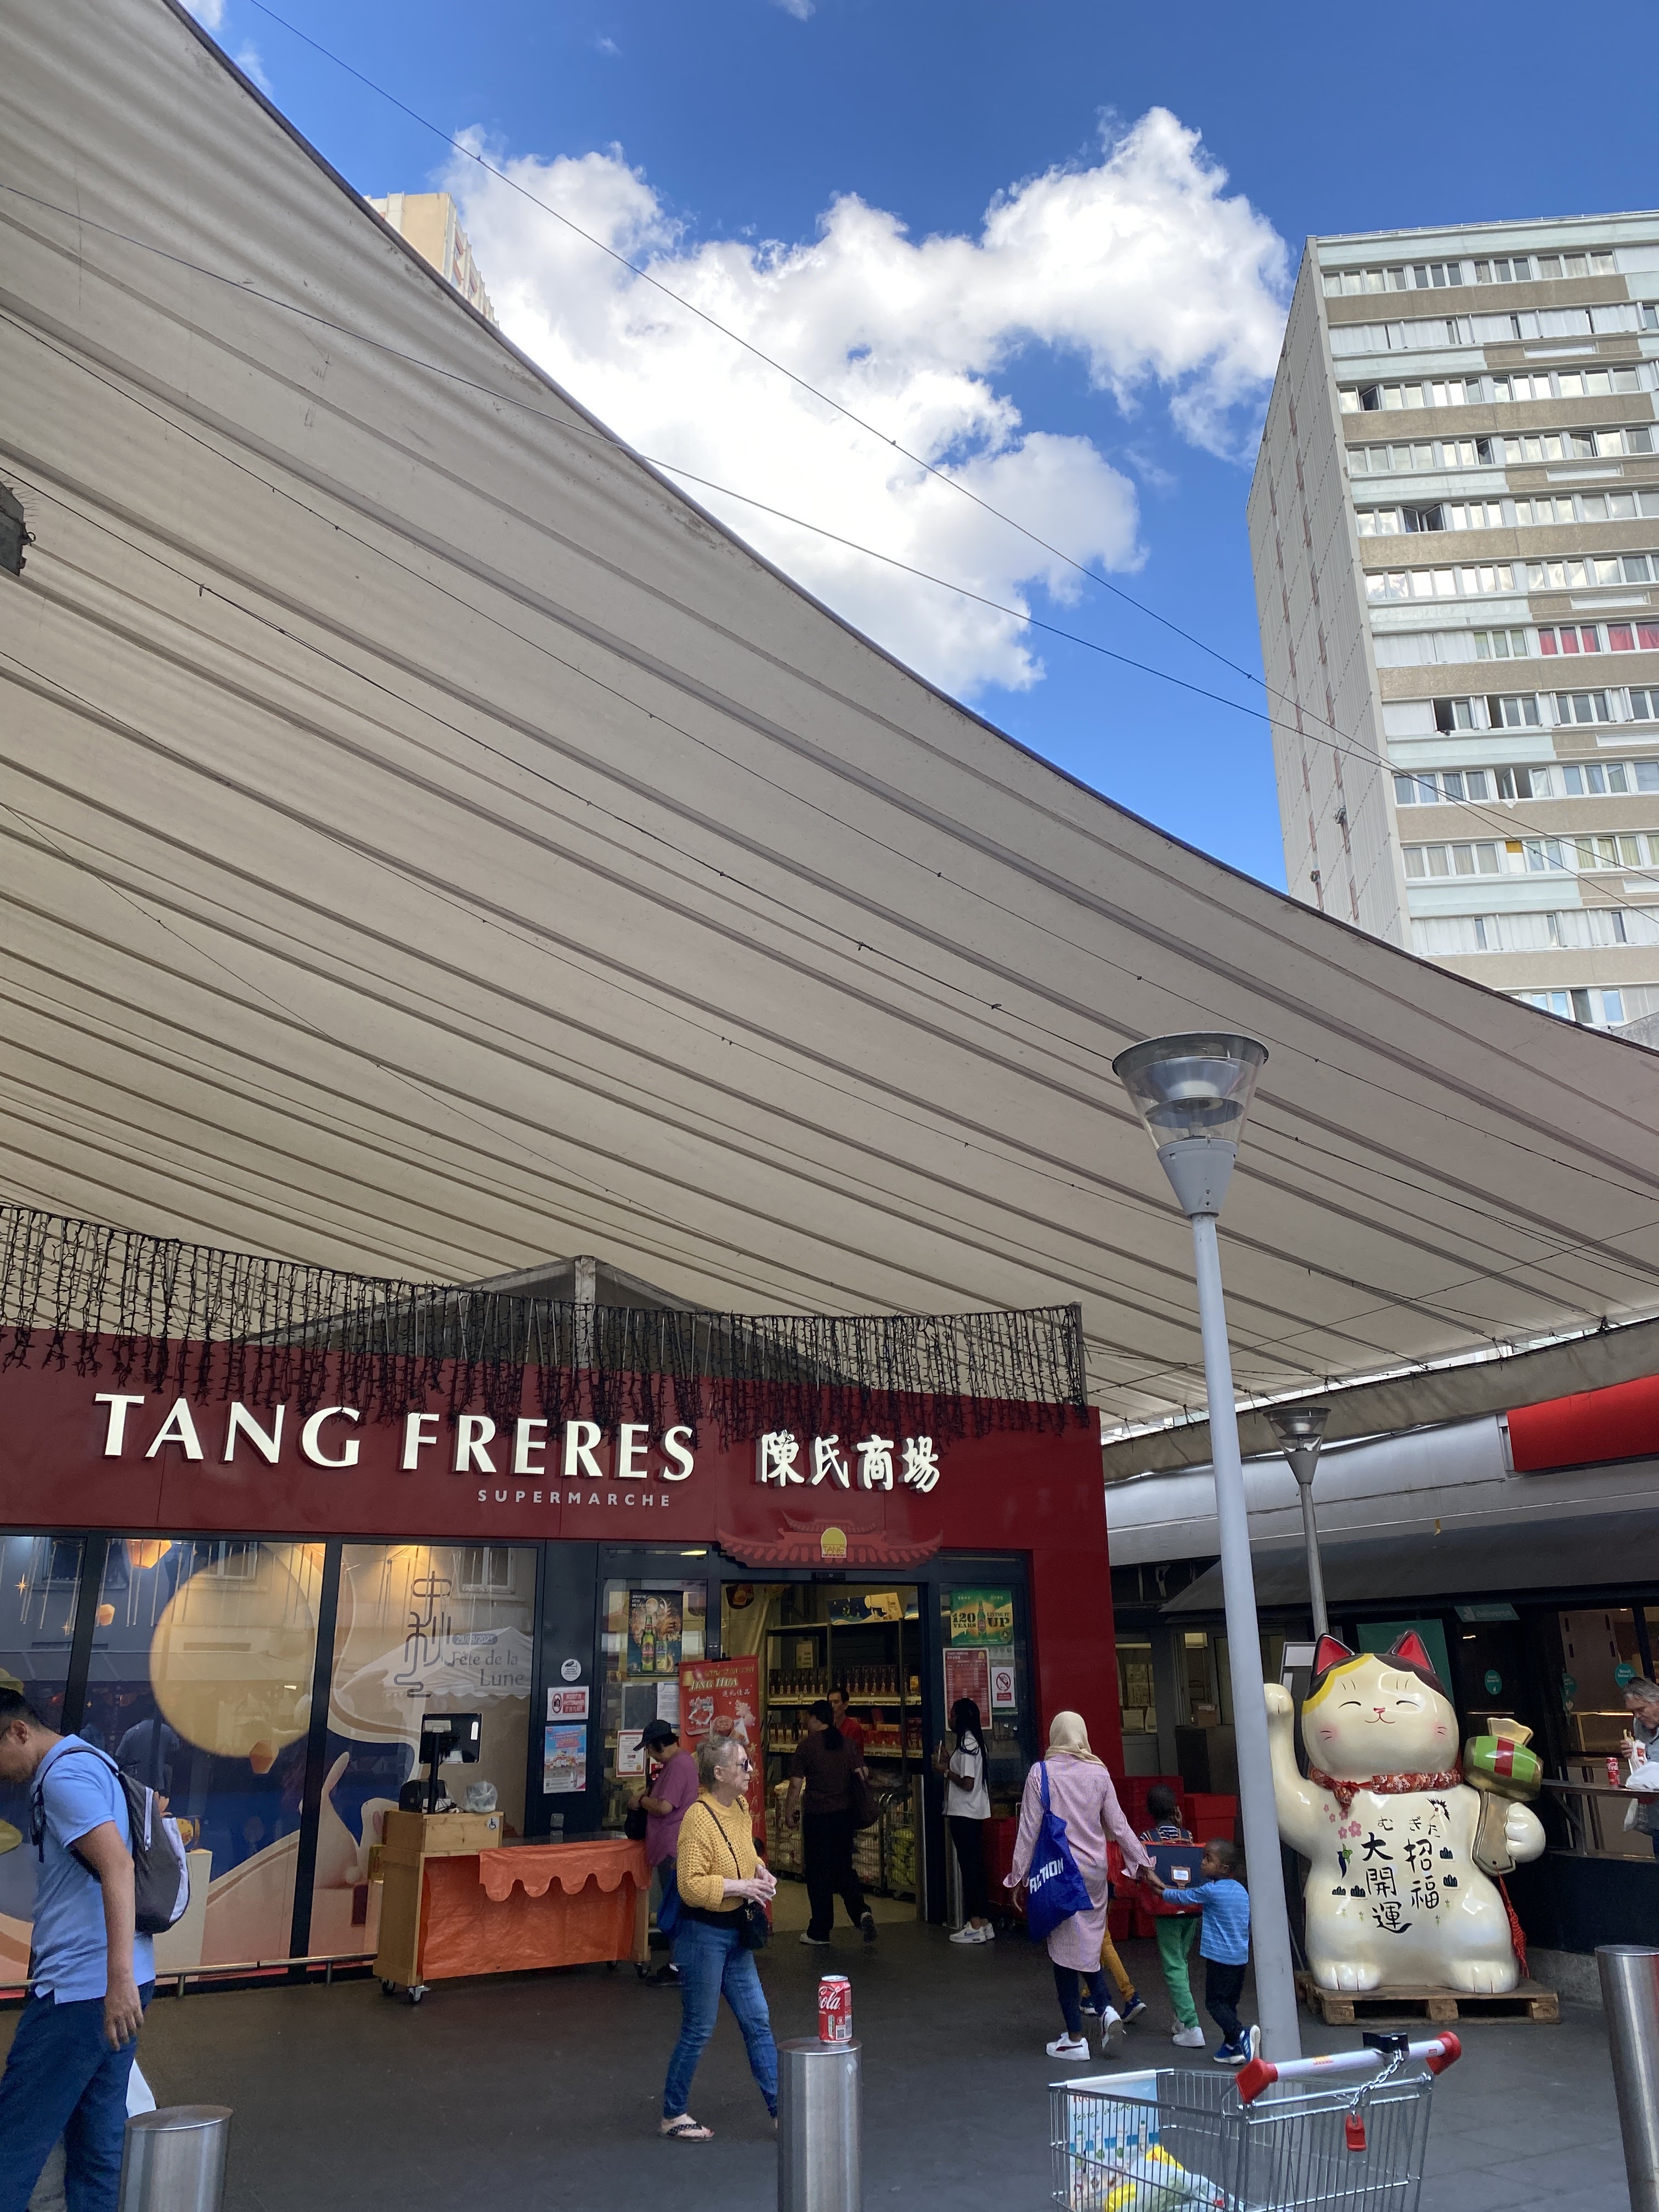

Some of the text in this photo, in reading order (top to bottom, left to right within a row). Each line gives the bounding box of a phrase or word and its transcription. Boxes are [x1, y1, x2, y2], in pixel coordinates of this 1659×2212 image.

[95, 1393, 695, 1481] TANG FRERES
[761, 1429, 940, 1493] 陳氏商場
[477, 1489, 670, 1507] SUPERMARCHE
[823, 1545, 845, 1554] TANG
[952, 1613, 976, 1623] 120
[987, 1617, 1010, 1627] UP
[452, 1649, 518, 1666] Fête de la
[479, 1668, 524, 1687] Lune
[689, 1677, 738, 1692] JING HUA
[1029, 1857, 1064, 1894] ACTION
[1361, 1832, 1413, 1934] 大開運
